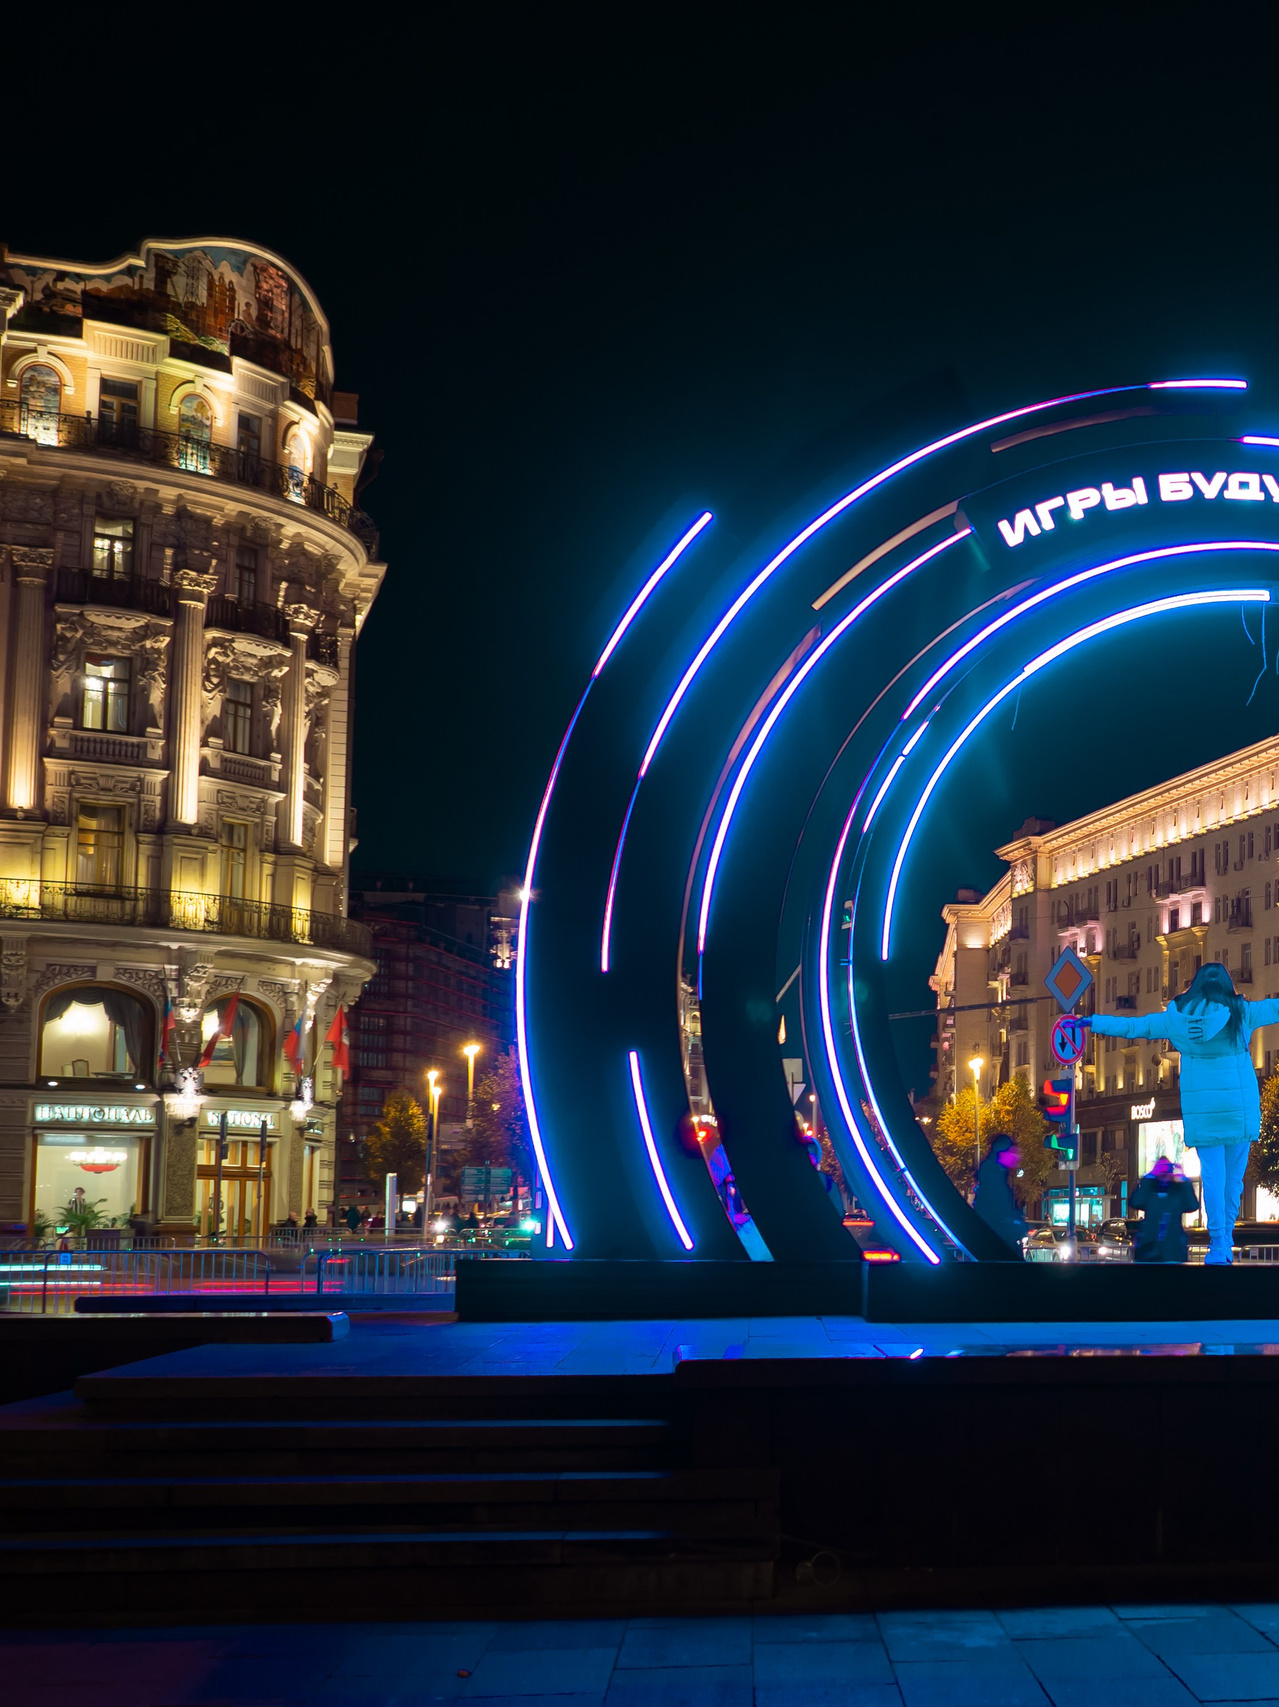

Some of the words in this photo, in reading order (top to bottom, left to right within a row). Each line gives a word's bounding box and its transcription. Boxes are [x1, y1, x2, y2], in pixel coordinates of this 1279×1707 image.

[997, 475, 1149, 547] ИГРЫ
[38, 1105, 154, 1121] НАЦИОНАЛЬ
[1131, 1102, 1154, 1120] BOSCO
